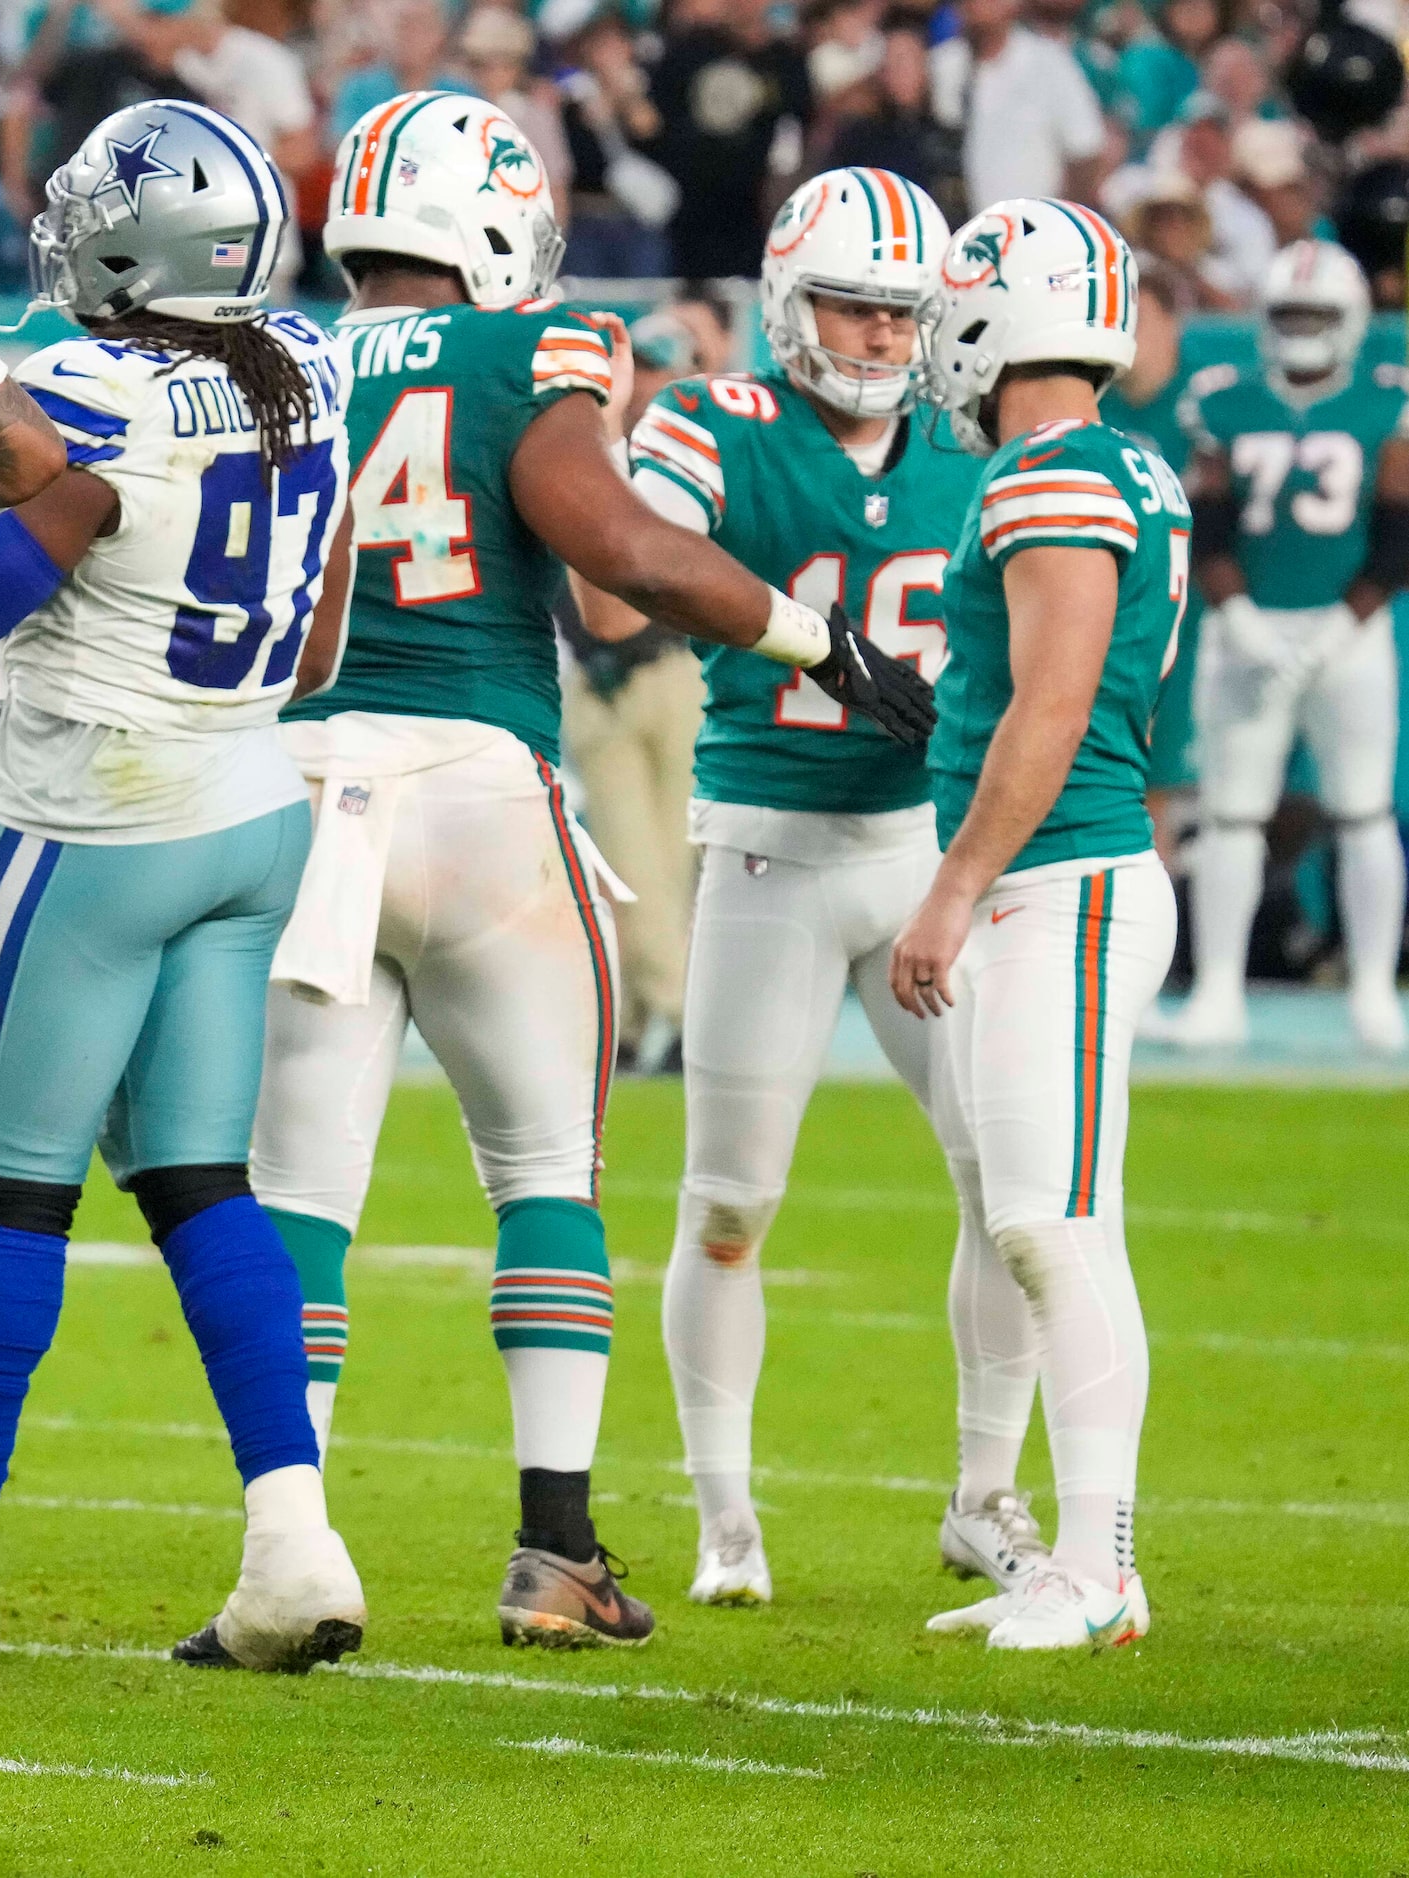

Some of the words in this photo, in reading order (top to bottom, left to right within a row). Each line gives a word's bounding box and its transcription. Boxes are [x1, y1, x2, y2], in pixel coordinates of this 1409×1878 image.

[165, 437, 337, 690] 97
[1230, 430, 1363, 536] 73
[774, 547, 952, 731] 16
